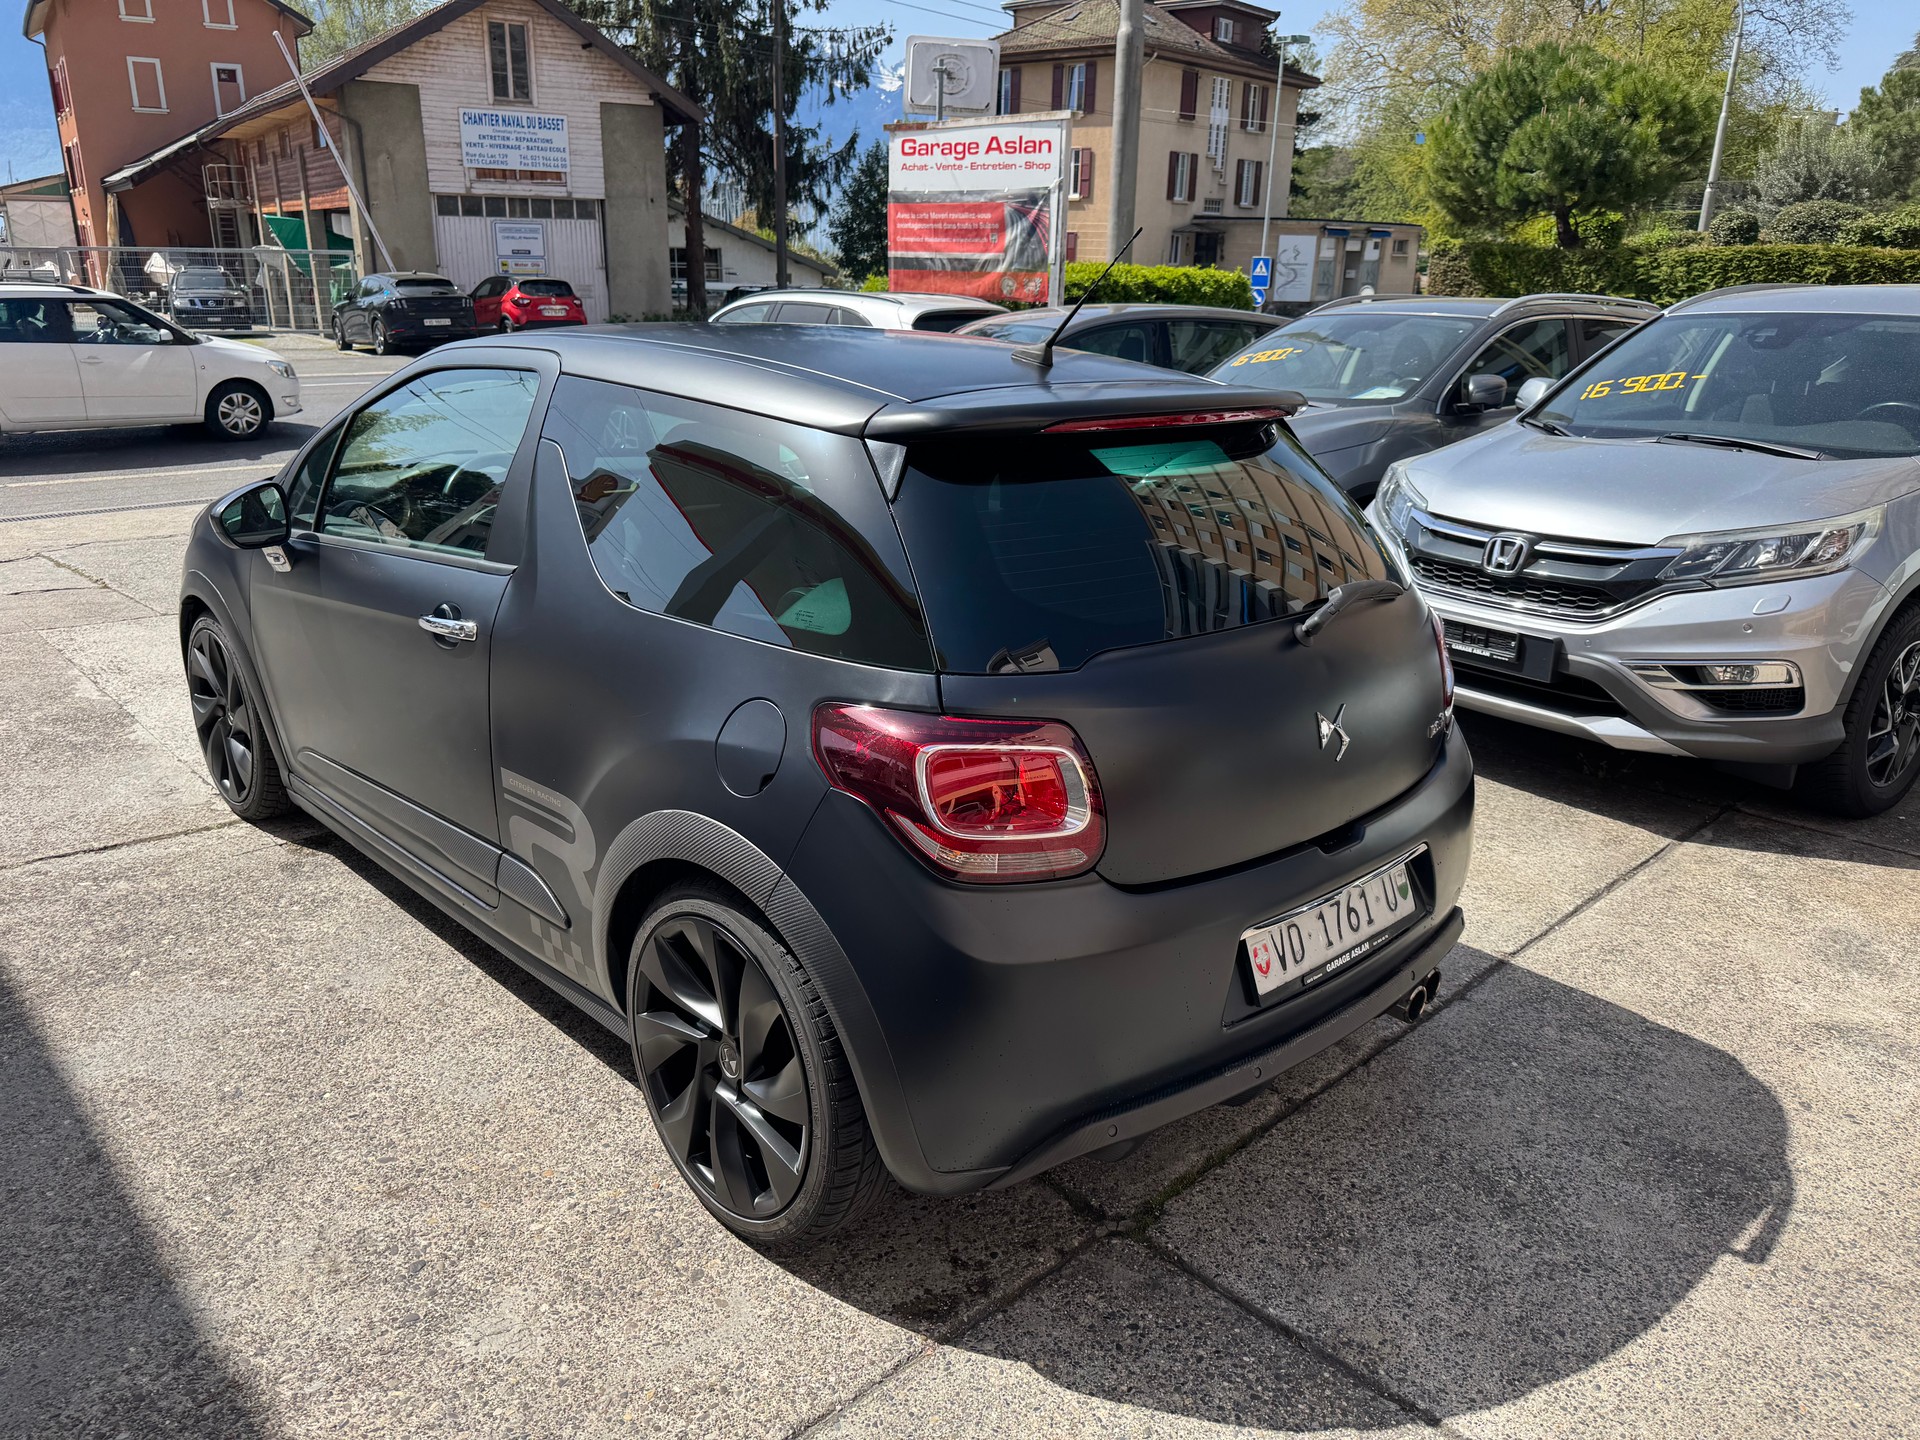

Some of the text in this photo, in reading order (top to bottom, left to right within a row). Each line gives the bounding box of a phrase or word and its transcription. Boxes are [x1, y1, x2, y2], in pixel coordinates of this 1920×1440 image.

[462, 112, 564, 131] CHANTIER NAVAL DU BASSET
[901, 135, 1052, 160] Garage Aslan
[901, 162, 928, 171] Achat
[935, 162, 963, 171] Vente
[970, 162, 1016, 170] Entretien
[1024, 161, 1051, 171] Shop
[1473, 648, 1490, 657] ASLAN
[537, 790, 561, 807] RACING
[1270, 874, 1398, 972] VD 1761 U
[1326, 942, 1370, 972] GARAGE ASLAN
